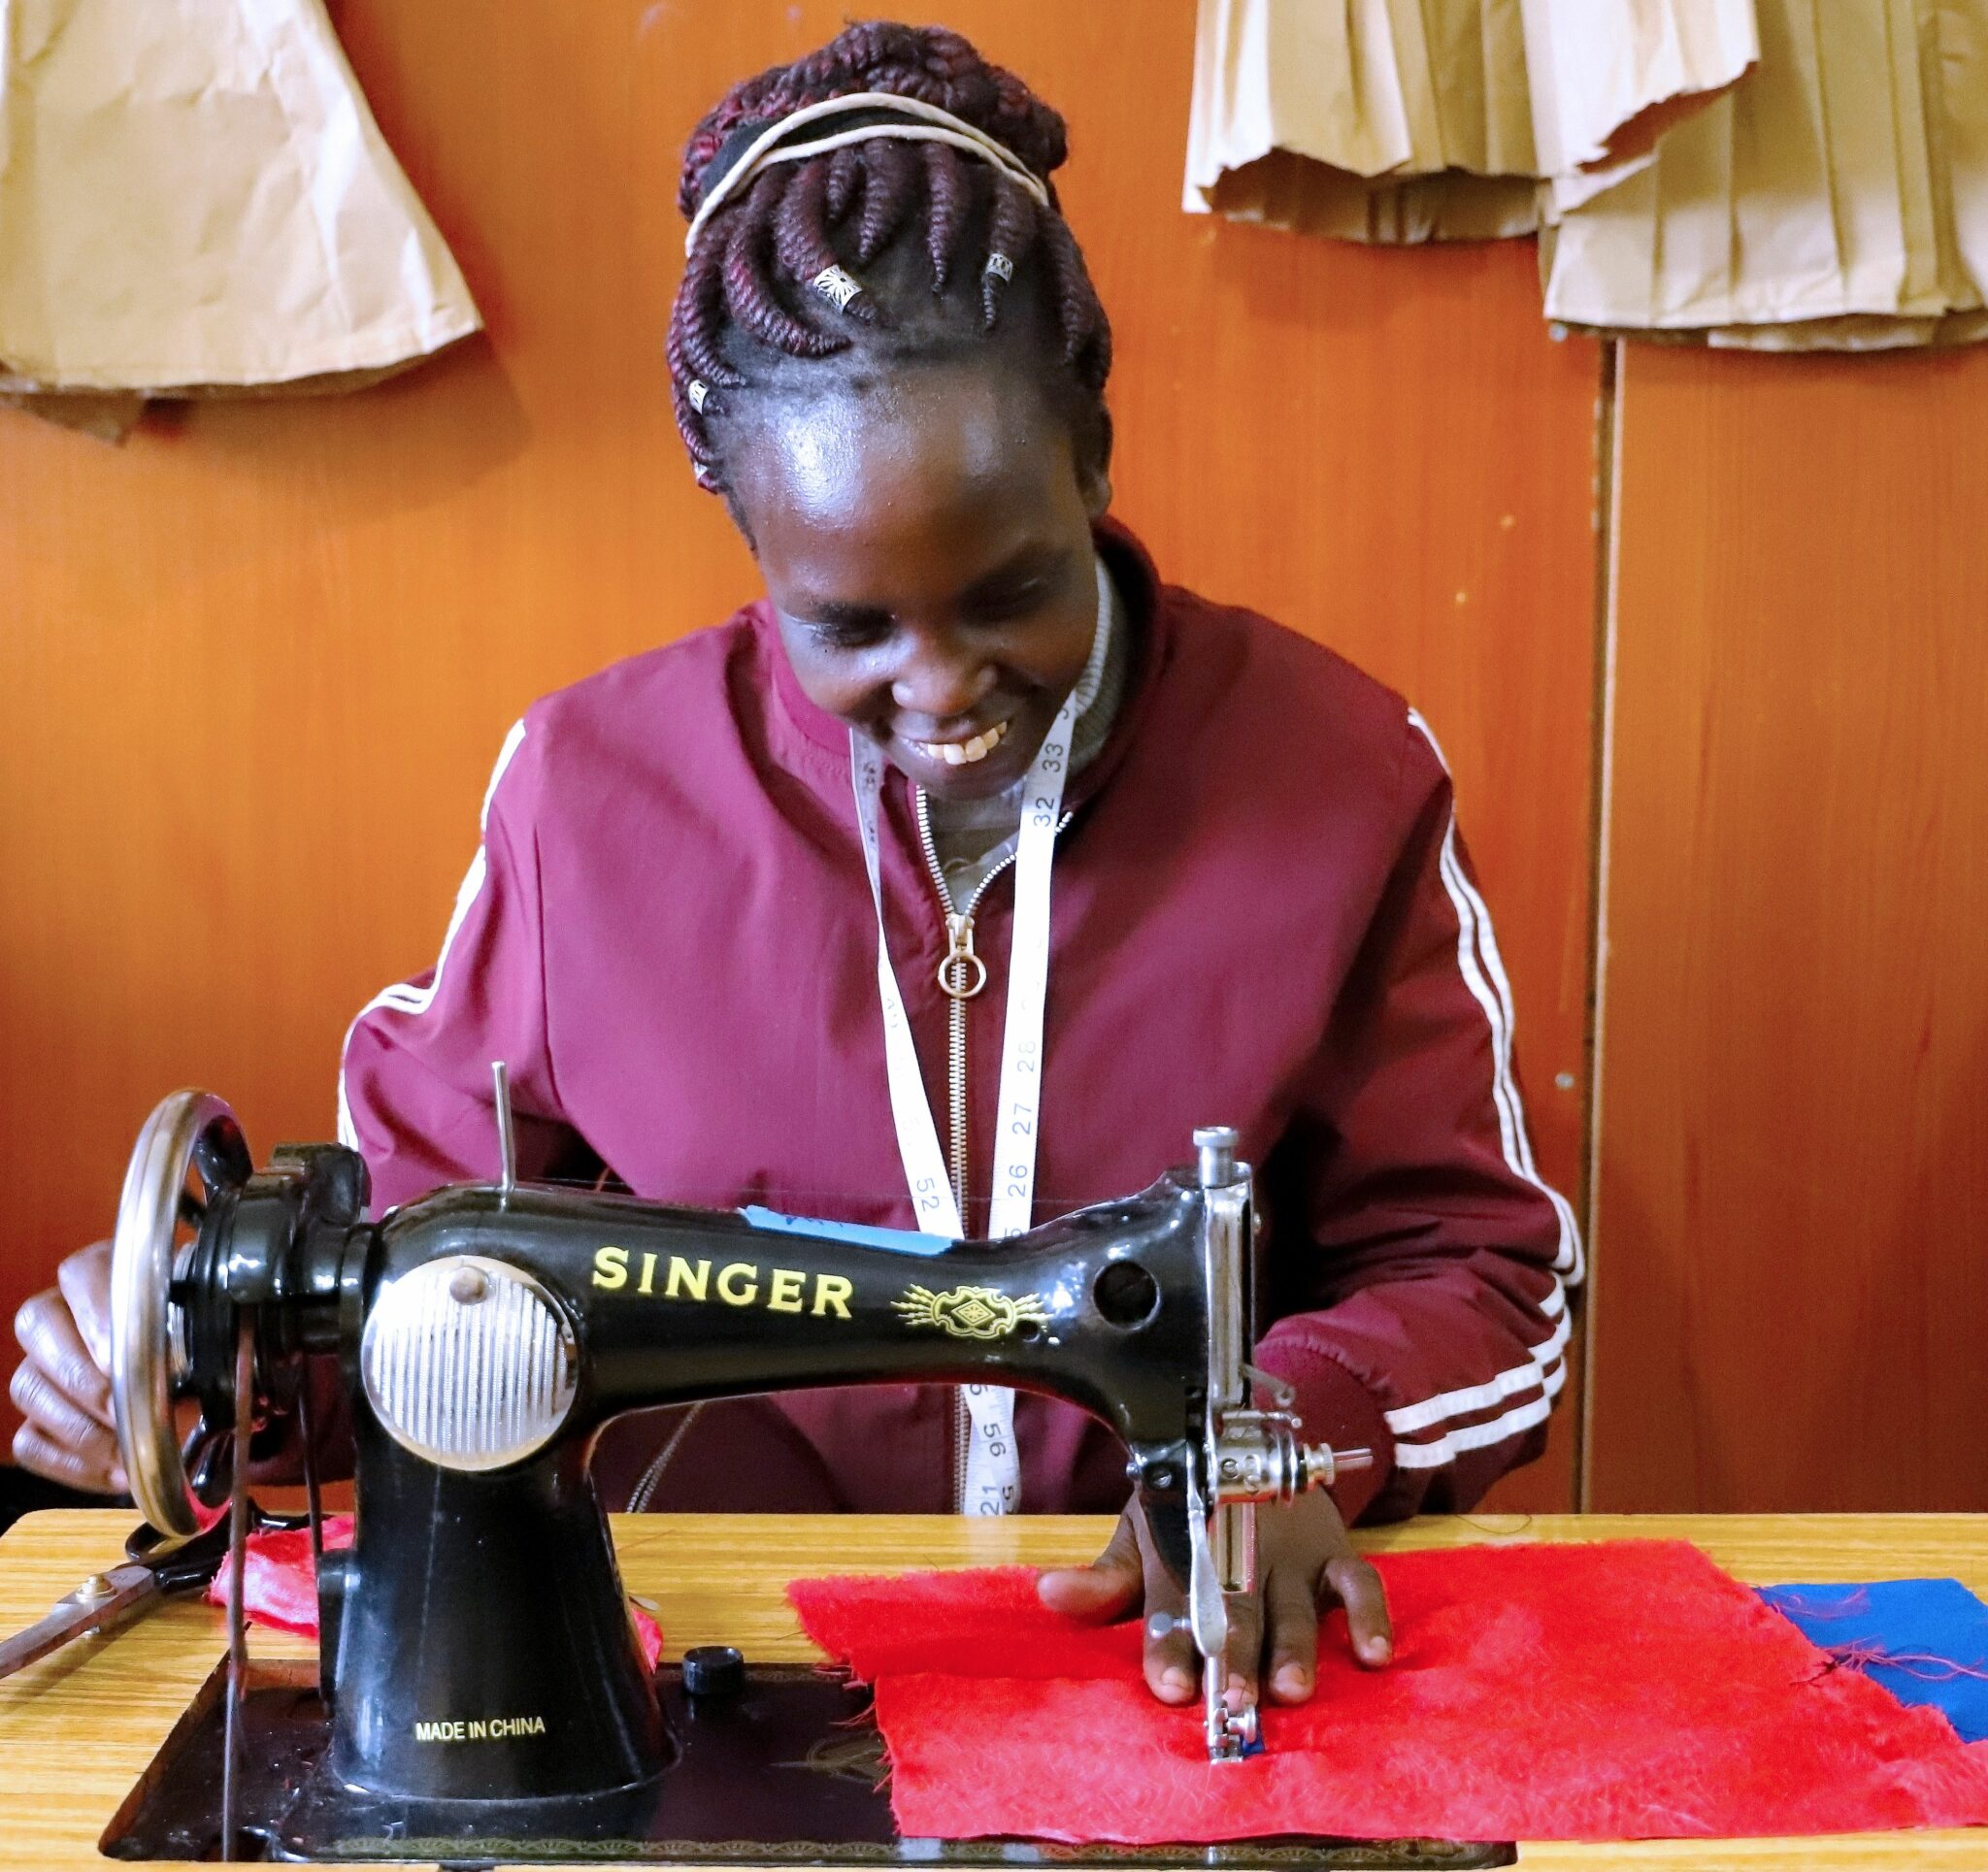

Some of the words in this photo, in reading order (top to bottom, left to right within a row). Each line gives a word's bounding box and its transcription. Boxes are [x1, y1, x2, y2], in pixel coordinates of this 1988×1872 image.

[1042, 742, 1064, 772] 33
[1033, 797, 1055, 828] 32
[1012, 1102, 1033, 1134] 27
[916, 1177, 940, 1212] 52
[1008, 1165, 1028, 1197] 26
[592, 1246, 853, 1320] SINGER
[983, 1423, 1007, 1458] 56
[980, 1485, 1000, 1516] 21
[415, 1722, 465, 1740] MADE
[468, 1721, 487, 1738] IN
[489, 1716, 546, 1737] CHINA
